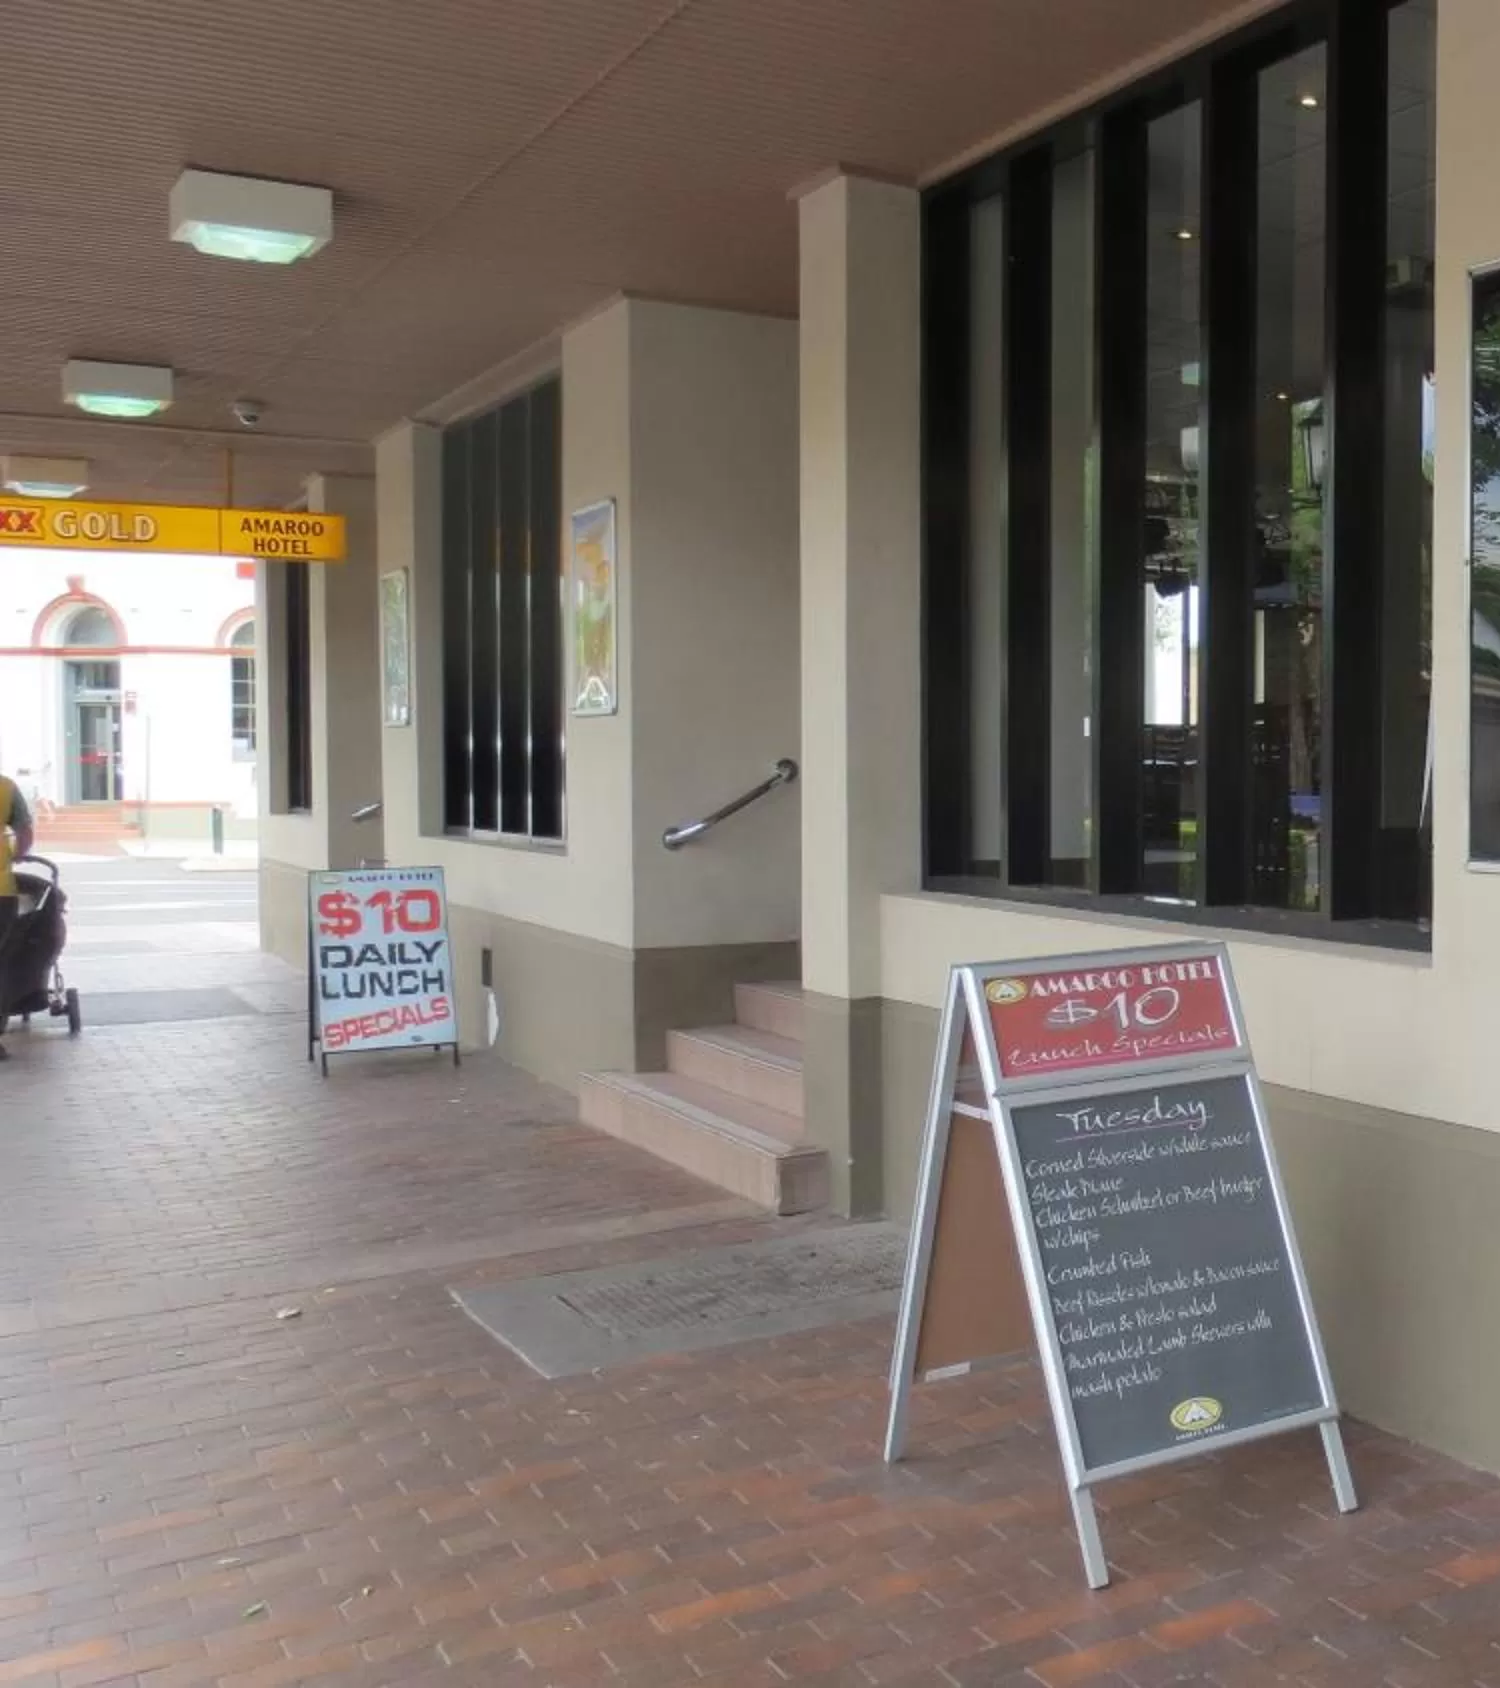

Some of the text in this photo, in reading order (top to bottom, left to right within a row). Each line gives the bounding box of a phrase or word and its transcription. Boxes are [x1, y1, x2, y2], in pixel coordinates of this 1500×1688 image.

[53, 510, 158, 543] GOLD
[240, 517, 325, 537] AMAROO
[253, 537, 313, 555] HOTEL
[318, 888, 441, 939] $10
[320, 939, 445, 969] DAILY
[321, 968, 445, 999] LUNCH
[1030, 960, 1216, 997] AMAROO HOTEL
[324, 996, 450, 1048] SPECIALS
[1047, 986, 1180, 1030] $10
[1008, 1024, 1230, 1067] Lunch Specials
[1055, 1096, 1213, 1132] Tuesday
